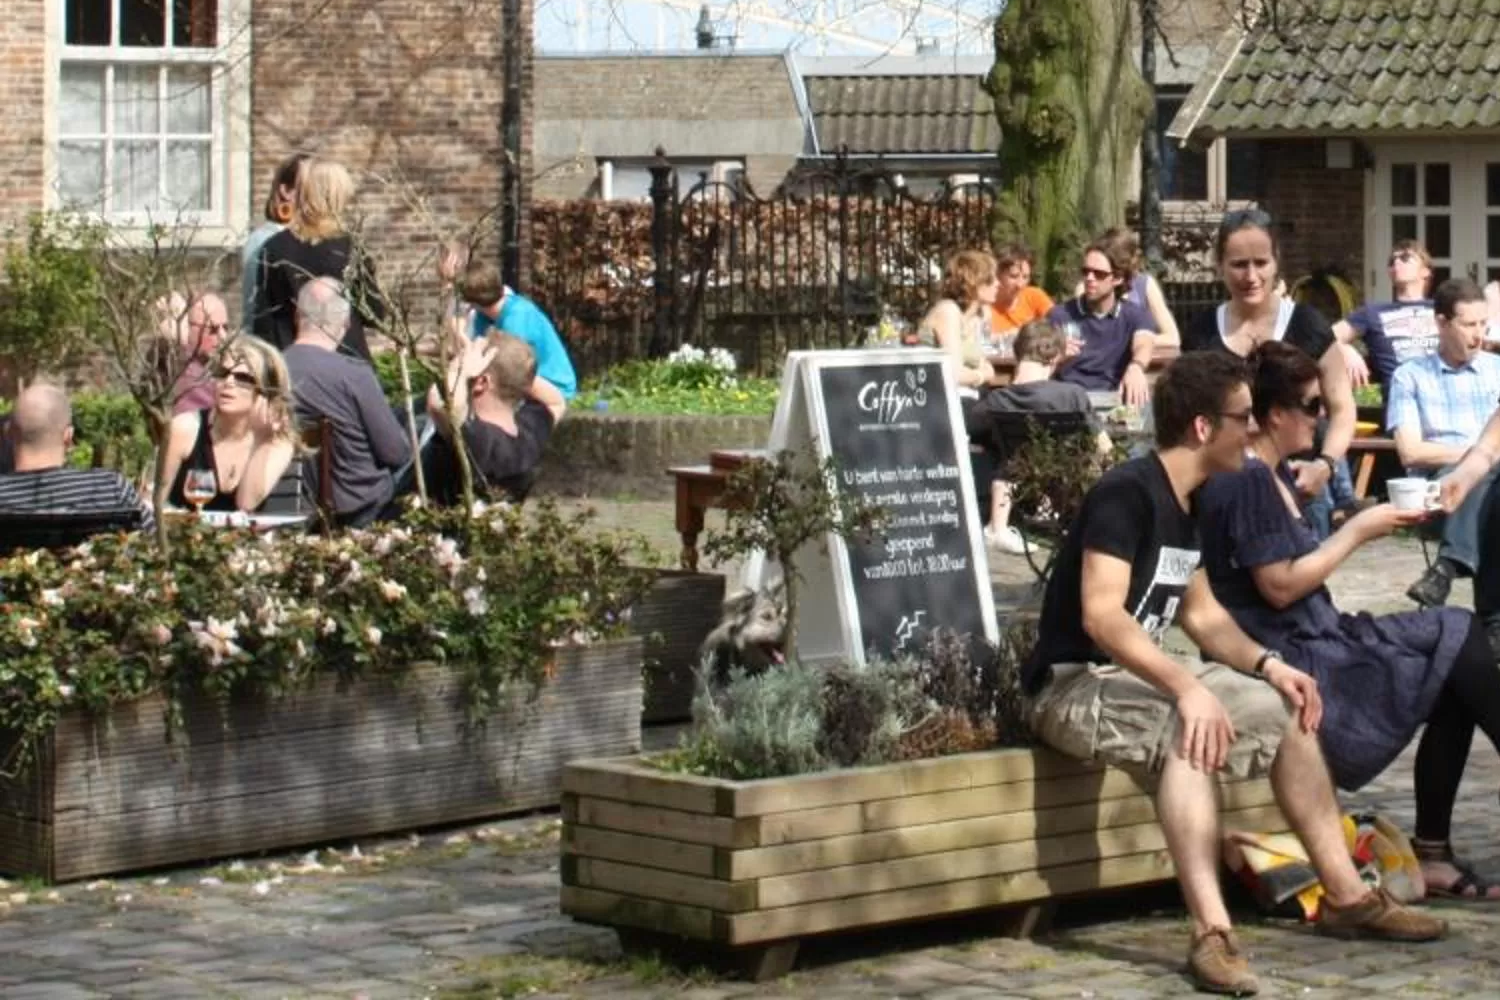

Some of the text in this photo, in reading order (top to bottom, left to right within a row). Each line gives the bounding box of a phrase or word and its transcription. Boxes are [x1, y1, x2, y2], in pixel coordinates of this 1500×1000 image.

[844, 471, 853, 484] U
[856, 467, 879, 484] bent
[885, 532, 935, 559] geopend
